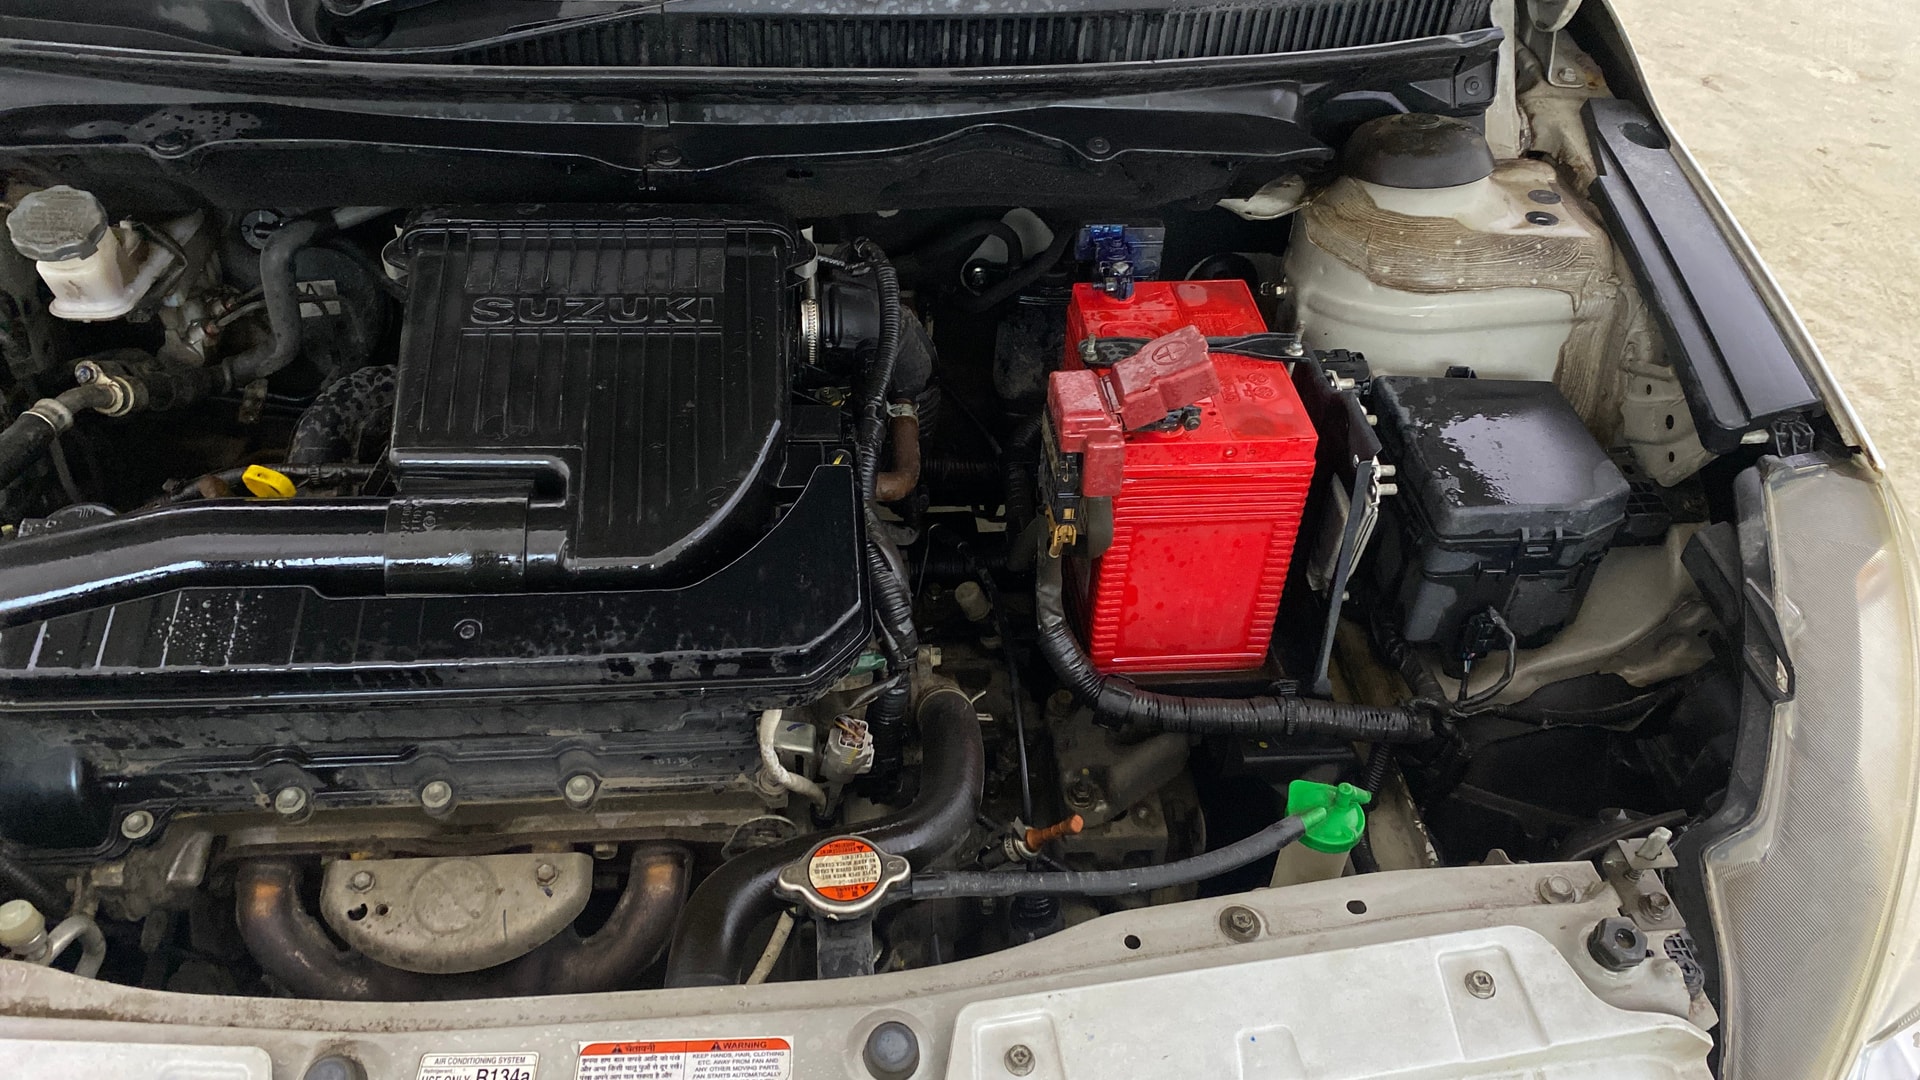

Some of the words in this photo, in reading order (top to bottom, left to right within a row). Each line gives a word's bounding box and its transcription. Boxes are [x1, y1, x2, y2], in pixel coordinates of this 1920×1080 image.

[470, 297, 714, 324] SUZUKI
[723, 1041, 767, 1049] WARNING
[476, 1068, 530, 1080] R134a
